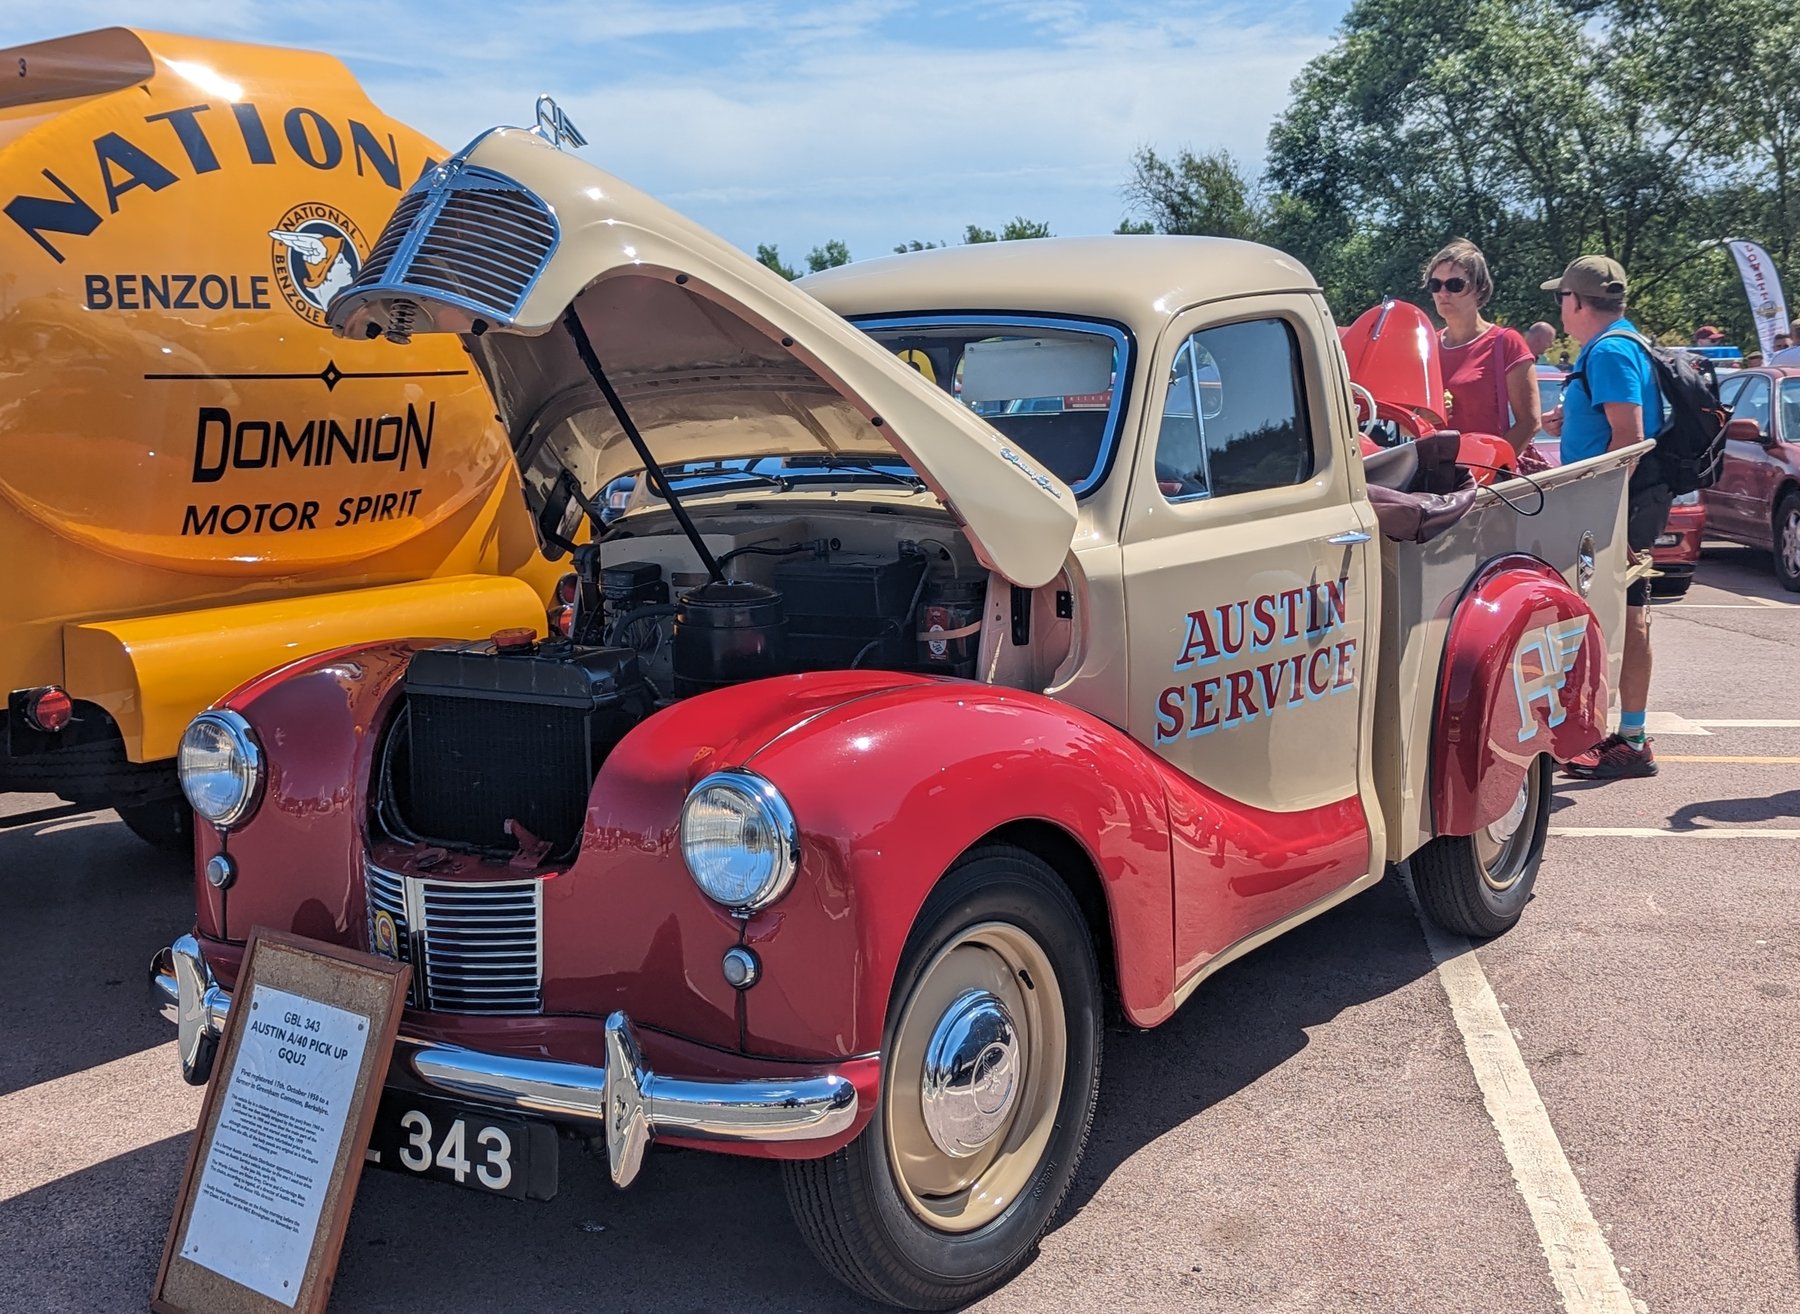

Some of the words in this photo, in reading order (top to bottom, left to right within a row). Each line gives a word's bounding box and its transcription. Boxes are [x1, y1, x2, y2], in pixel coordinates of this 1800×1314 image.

[18, 57, 27, 77] 3
[3, 102, 448, 264] NATION
[281, 205, 357, 240] NATIONAL
[85, 274, 271, 310] BENZOLE
[274, 254, 322, 322] BENZOLE
[192, 401, 436, 483] DOMINION
[181, 501, 321, 536] MOTOR
[335, 488, 422, 527] SPIRIT
[1173, 577, 1349, 672] AUSTIN
[1155, 638, 1357, 747] SERVICE
[251, 1020, 287, 1041] AUSTIN
[287, 1032, 308, 1048] A/40
[309, 1038, 333, 1057] PICK
[333, 1046, 348, 1061] UP
[284, 1011, 302, 1027] GBL
[304, 1018, 321, 1033] 343
[278, 1047, 307, 1066] GQU2
[286, 1084, 307, 1097] October
[400, 1110, 511, 1190] 343
